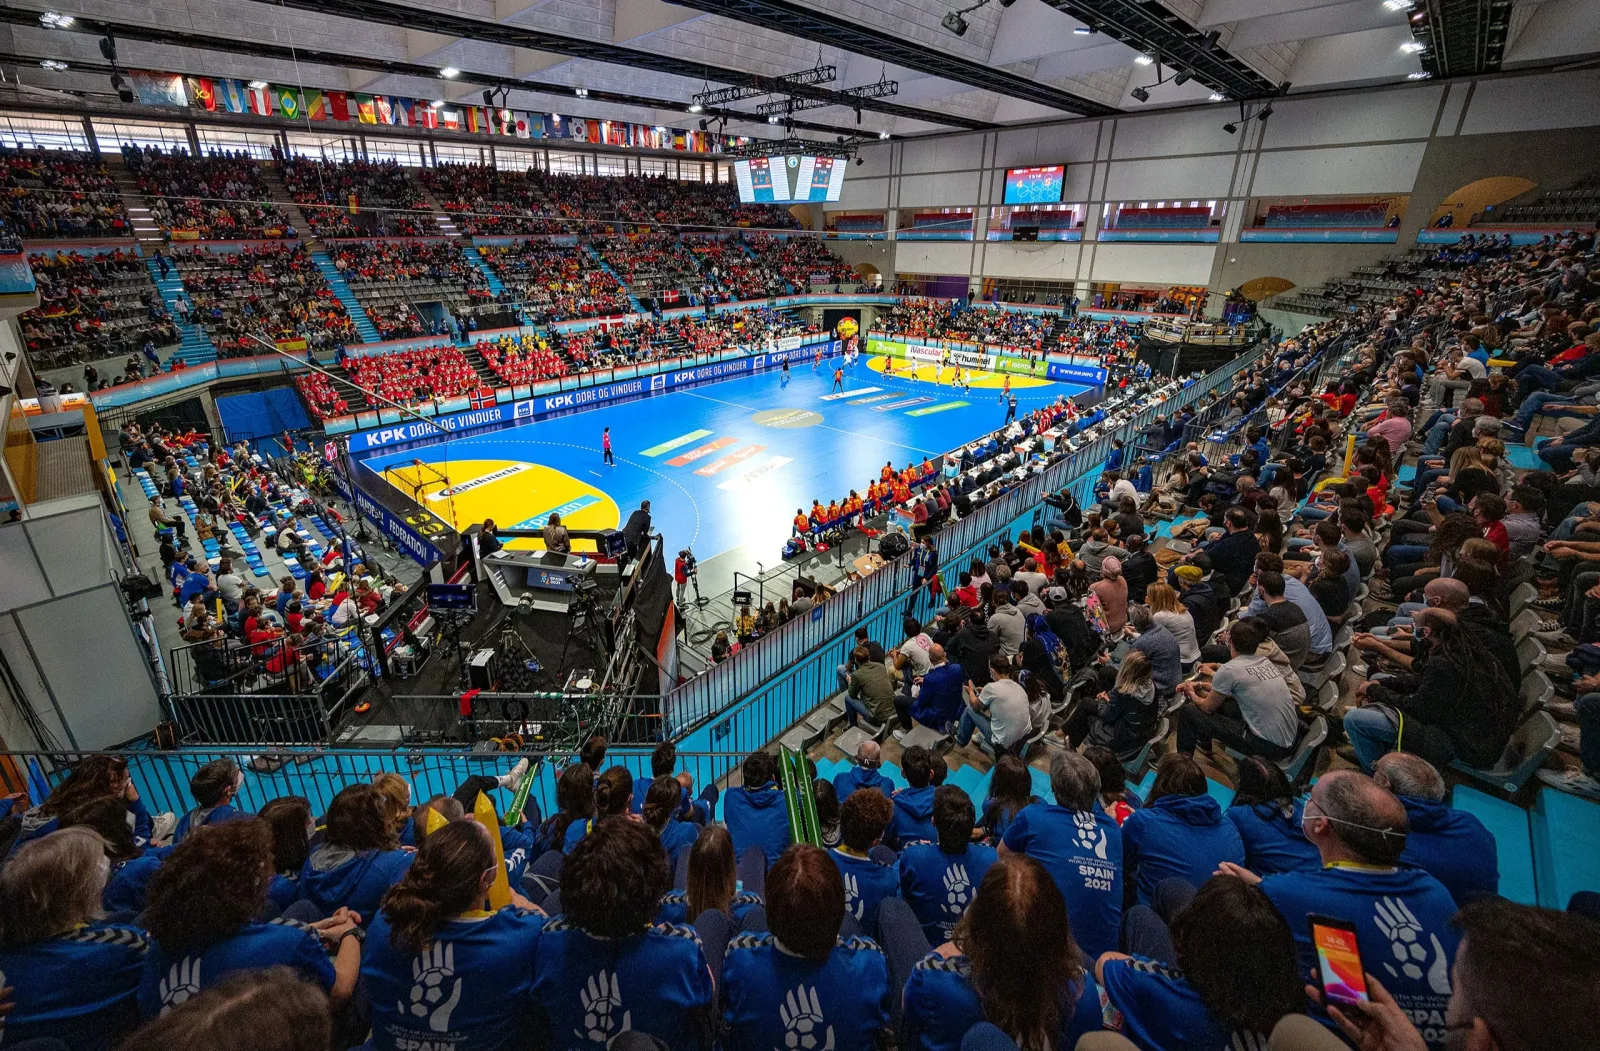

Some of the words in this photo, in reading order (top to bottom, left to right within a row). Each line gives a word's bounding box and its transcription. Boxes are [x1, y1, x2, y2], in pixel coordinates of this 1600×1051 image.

[910, 346, 942, 357] iVascular
[674, 370, 695, 383] KPK
[714, 365, 722, 375] OG
[723, 360, 747, 373] VINDUER
[545, 394, 574, 409] KPK
[575, 389, 596, 404] DØRE
[598, 387, 609, 399] OG
[611, 381, 642, 396] VINDUER
[366, 427, 407, 446] KPK
[409, 420, 439, 438] DØRE
[441, 417, 456, 430] OG
[457, 408, 502, 428] VINDUER
[389, 519, 428, 560] FEDERATION
[1079, 864, 1114, 880] SPAIN
[1084, 877, 1111, 891] 2021
[395, 1037, 456, 1051] SPAIN
